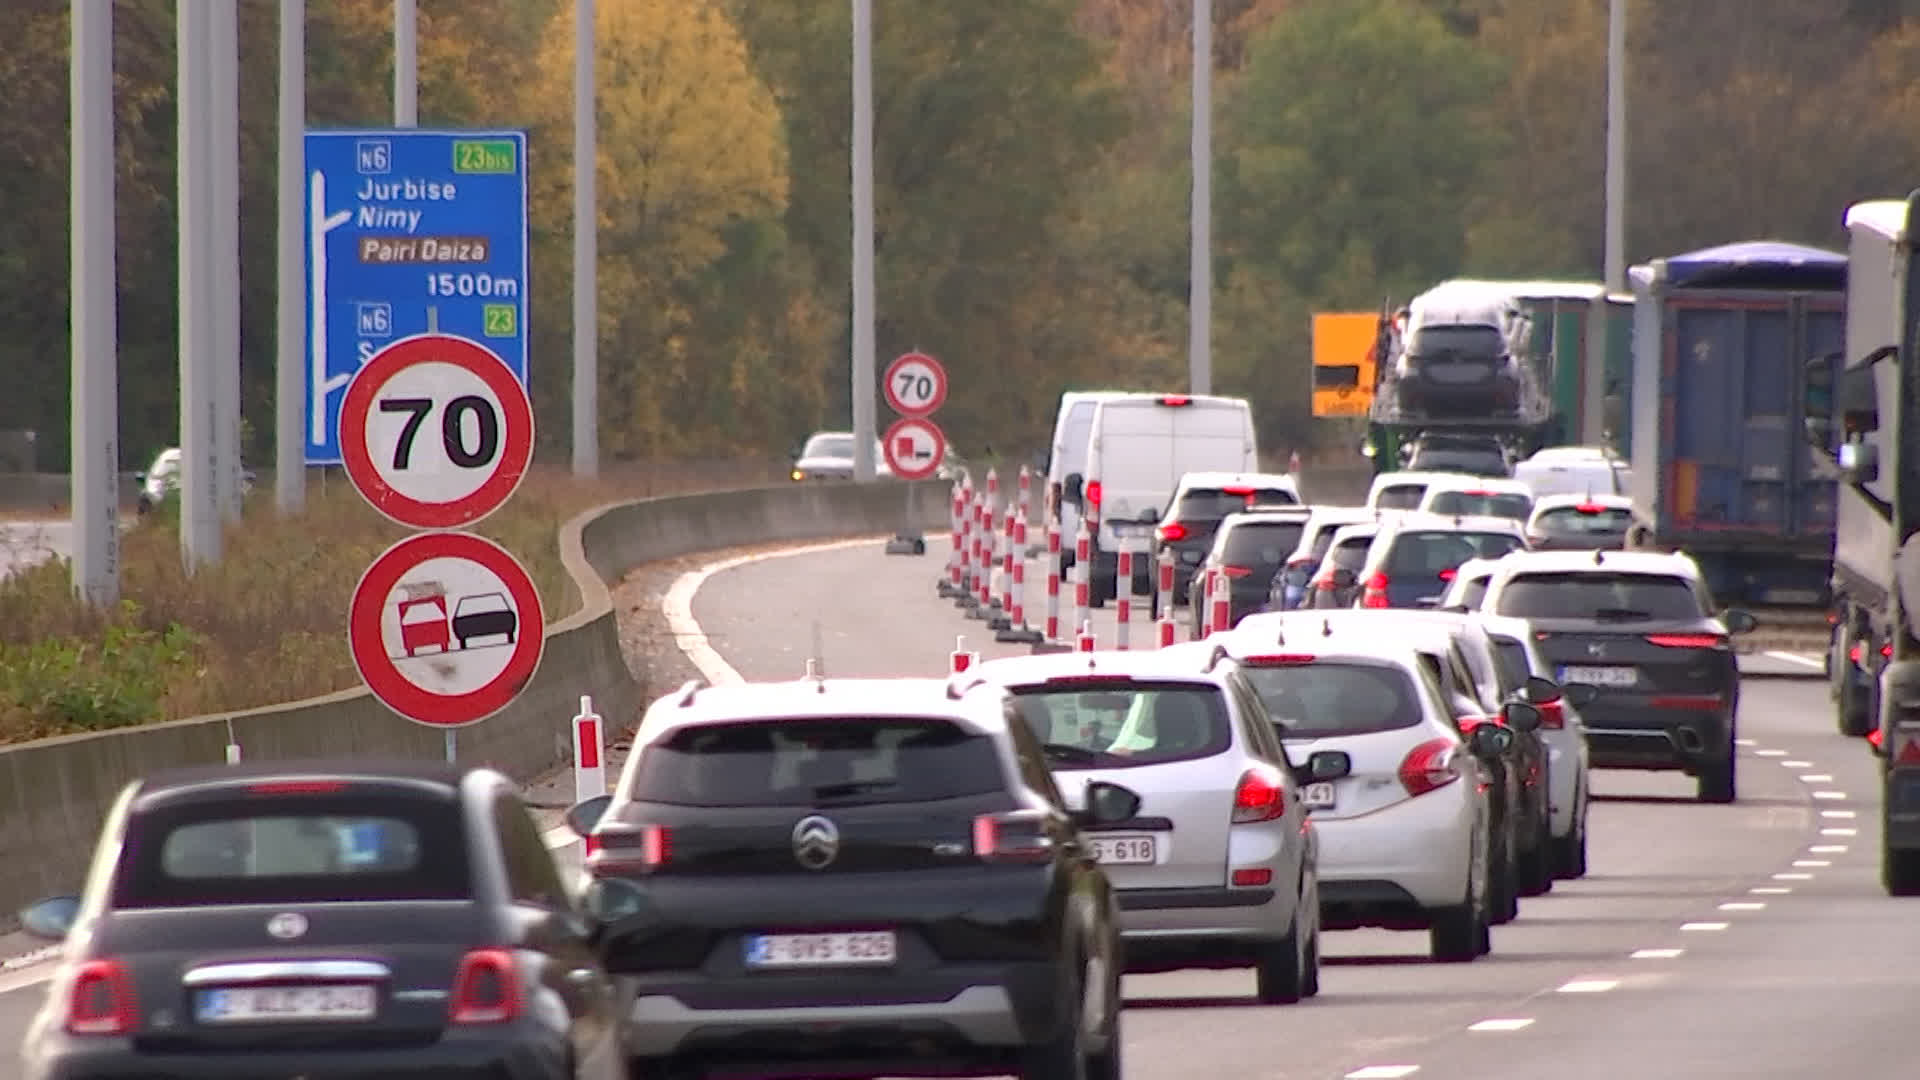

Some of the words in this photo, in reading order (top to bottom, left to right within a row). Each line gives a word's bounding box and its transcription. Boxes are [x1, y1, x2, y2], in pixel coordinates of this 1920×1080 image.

[361, 147, 387, 170] N6
[460, 146, 510, 170] 23bis
[358, 179, 456, 200] Jurbise
[358, 206, 421, 233] Nimy
[364, 241, 415, 260] Pairi
[422, 241, 485, 260] Daiza
[428, 275, 517, 296] 1500m
[361, 309, 387, 330] N6
[488, 311, 513, 331] 23
[899, 373, 931, 400] 70
[379, 395, 498, 470] 70
